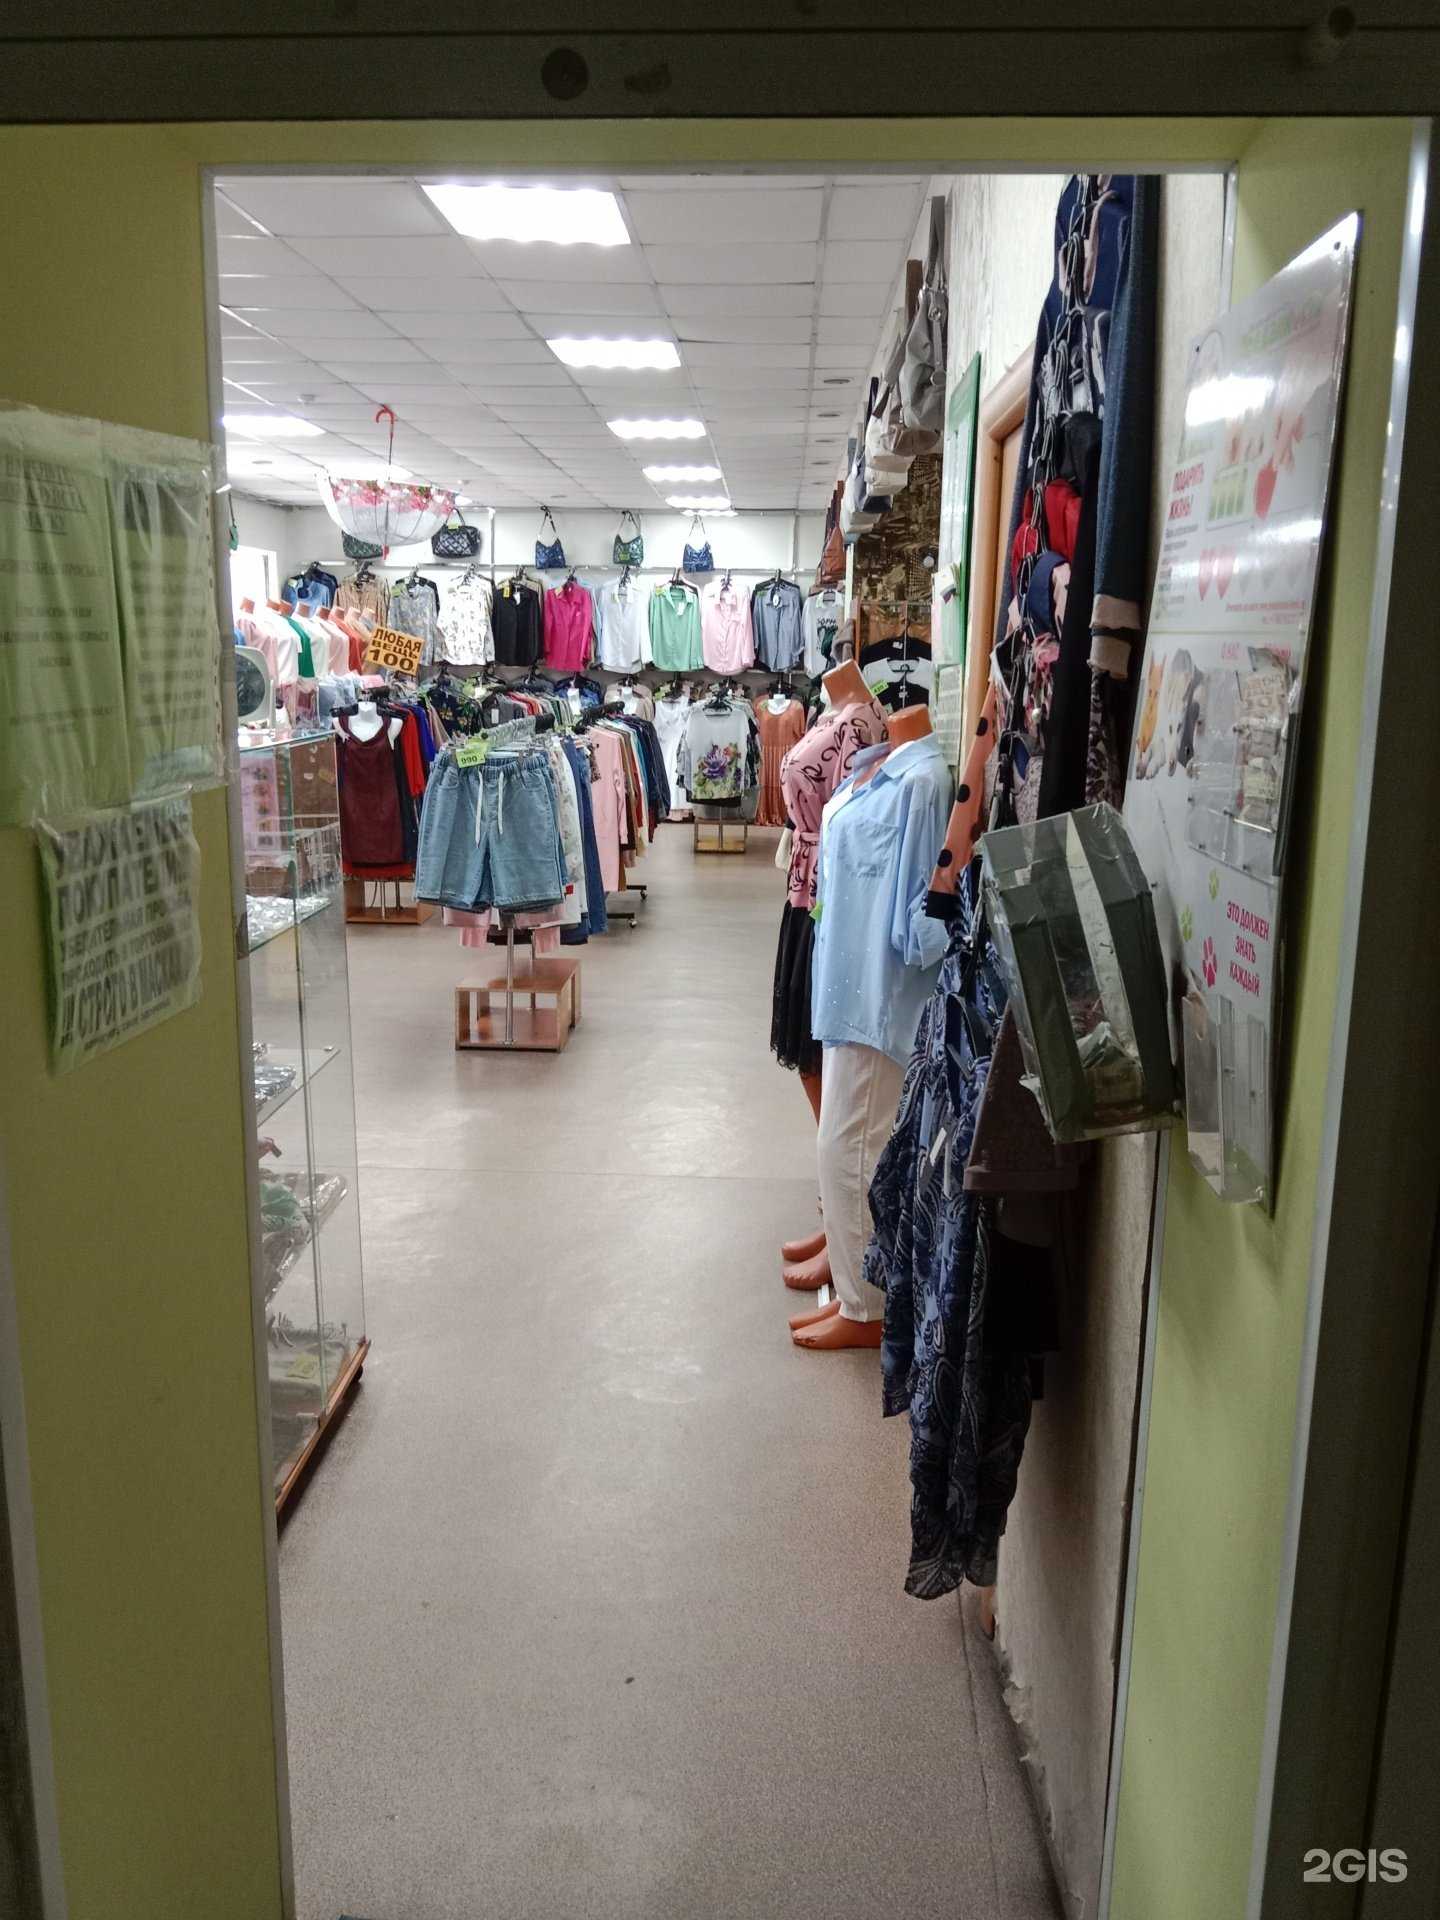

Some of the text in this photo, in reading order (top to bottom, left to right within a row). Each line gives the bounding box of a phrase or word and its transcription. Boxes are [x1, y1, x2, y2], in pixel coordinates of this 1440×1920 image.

[372, 640, 418, 660] ВЕЩЬ
[374, 628, 422, 653] ЛЮБАЯ
[1227, 901, 1270, 941] ЭТО ДОЛЖЕН
[1235, 936, 1256, 964] ЗНАТЬ
[1229, 961, 1261, 997] КАЖДЫЙ
